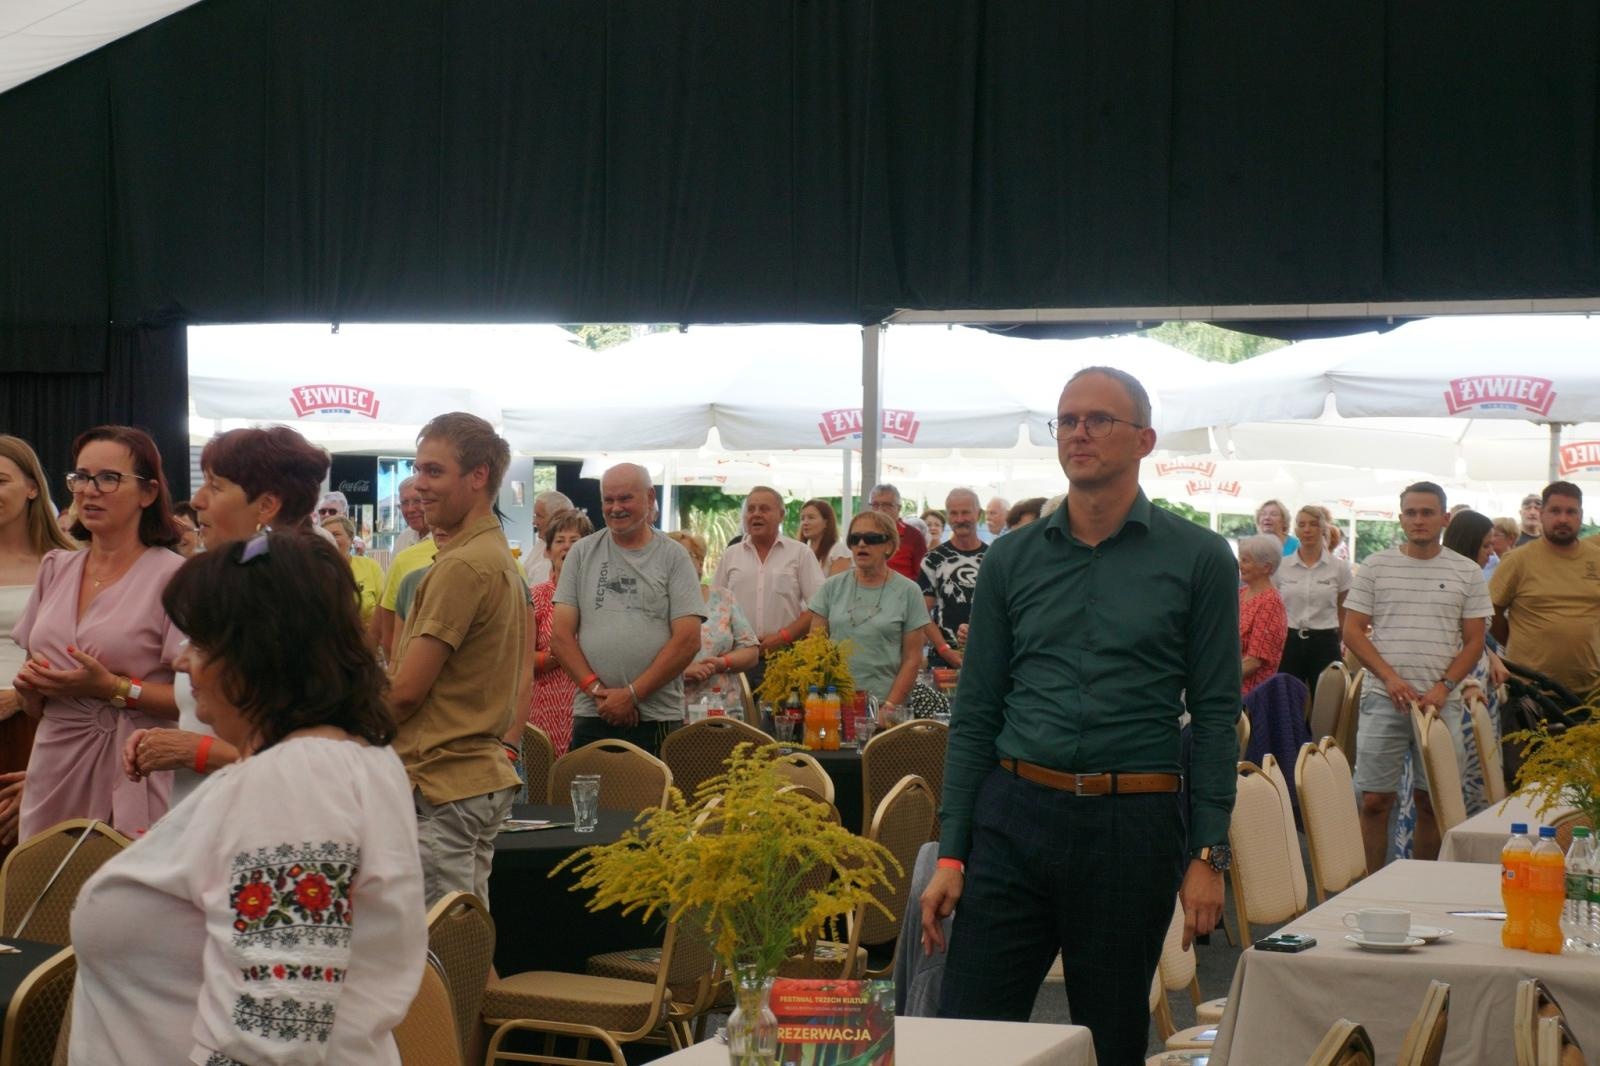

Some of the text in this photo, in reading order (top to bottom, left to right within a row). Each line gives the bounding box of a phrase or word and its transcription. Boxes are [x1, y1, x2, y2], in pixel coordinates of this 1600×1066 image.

[300, 386, 368, 408] ŻYWIEC
[1459, 377, 1545, 402] ŻYWIEC
[832, 411, 908, 433] ŻYEC
[777, 1027, 872, 1041] REZERWACJA
